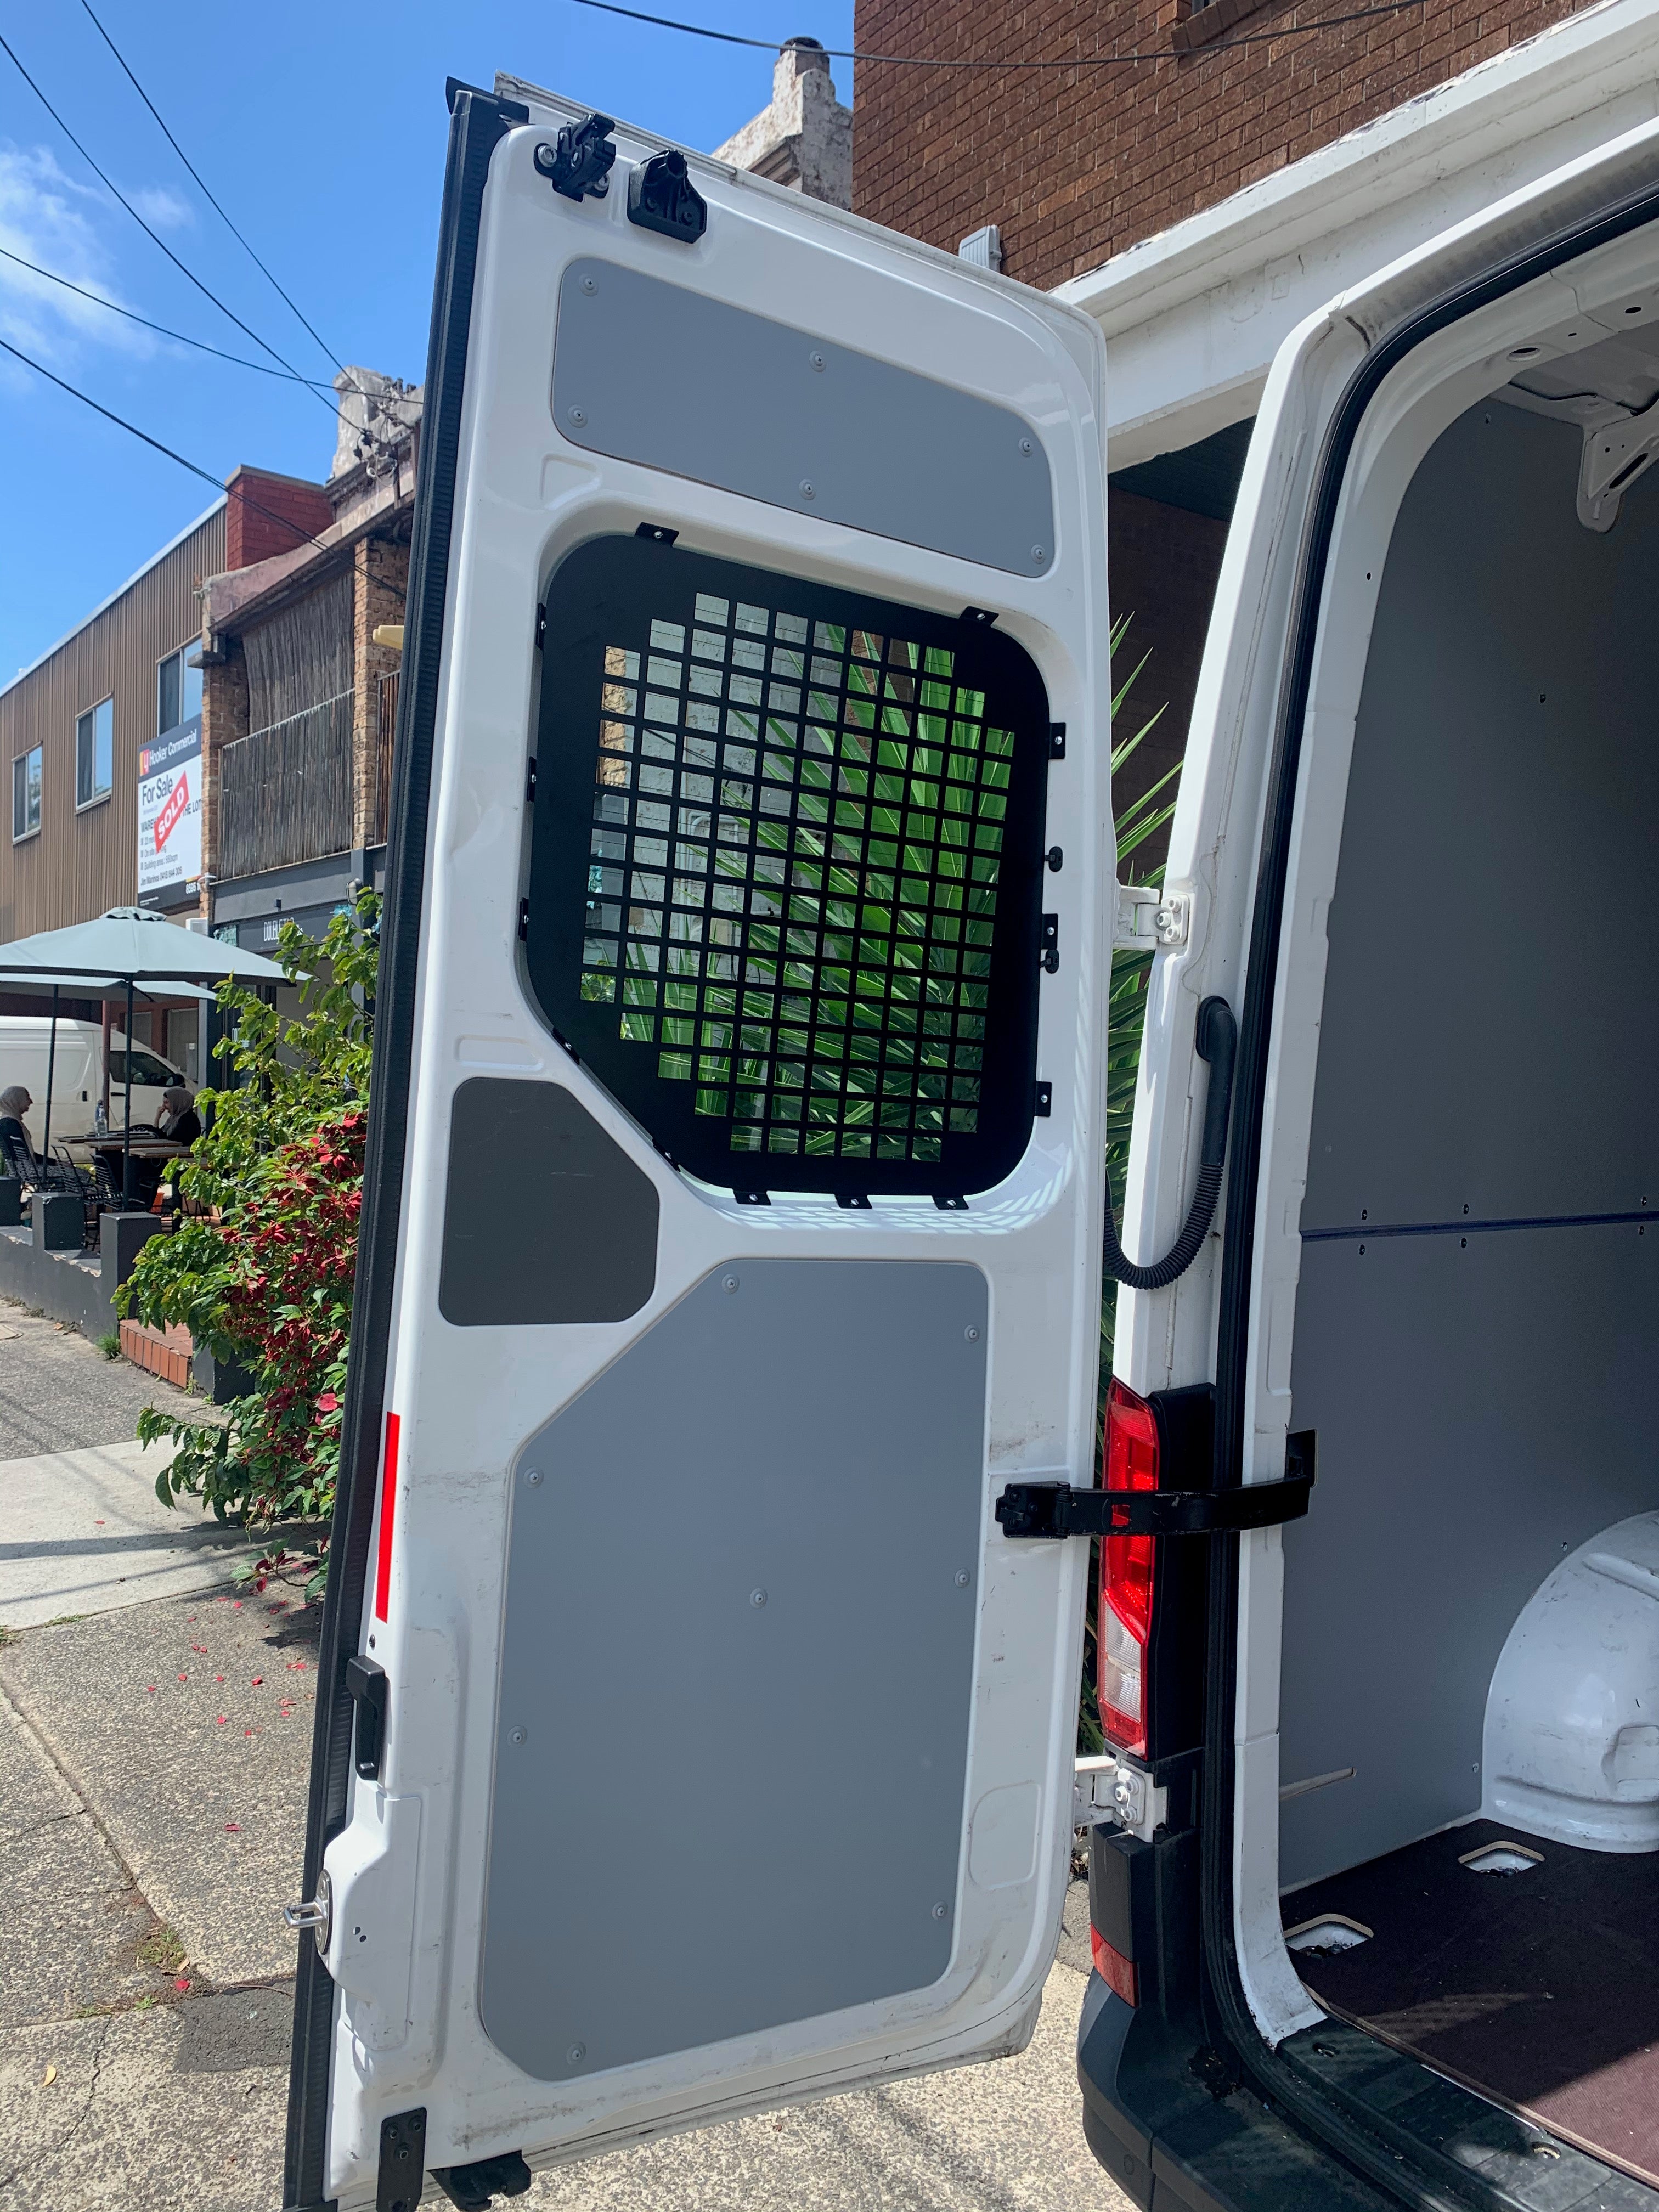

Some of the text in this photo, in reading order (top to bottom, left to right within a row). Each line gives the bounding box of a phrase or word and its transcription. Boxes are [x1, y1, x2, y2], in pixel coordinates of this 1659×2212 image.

[149, 746, 167, 766] Hooker
[168, 728, 197, 757] Commercial
[142, 774, 173, 806] For Sale
[157, 786, 184, 840] SOLD
